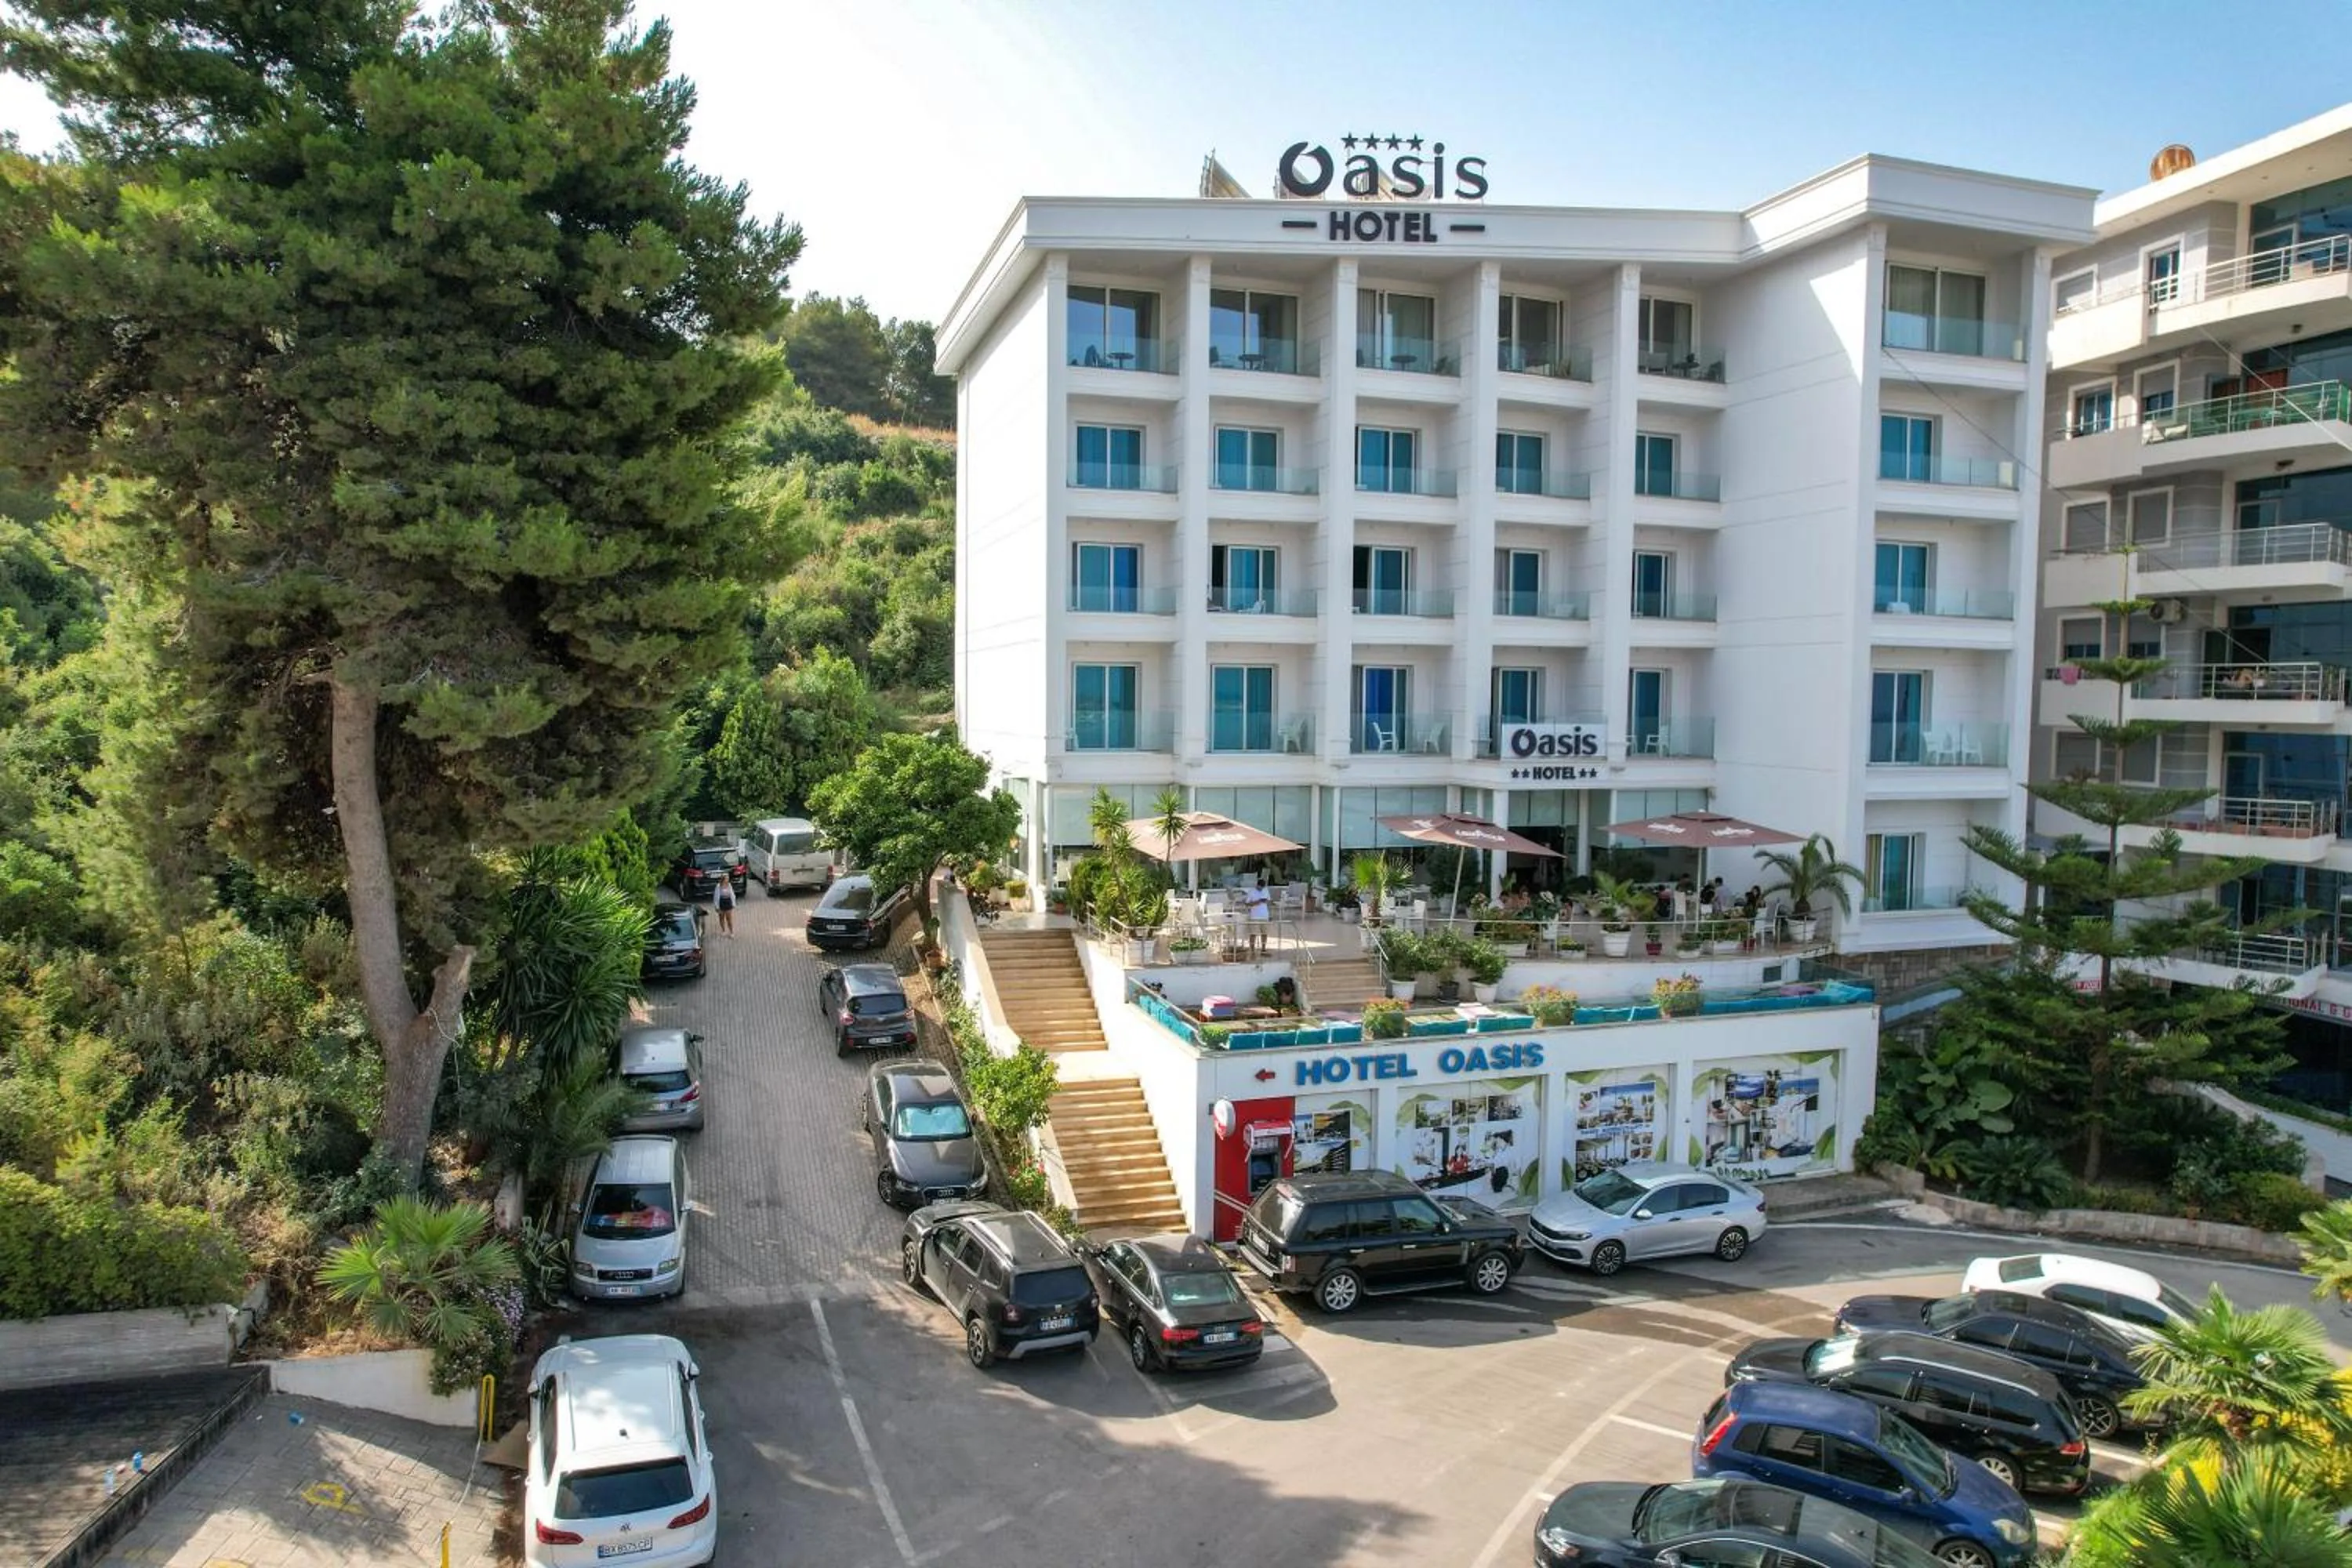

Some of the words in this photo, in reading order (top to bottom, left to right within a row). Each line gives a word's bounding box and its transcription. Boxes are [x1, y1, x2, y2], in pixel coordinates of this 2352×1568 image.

[1279, 142, 1488, 198] Oasis
[1330, 211, 1438, 242] HOTEL
[1512, 726, 1598, 757] Oasis
[1533, 767, 1576, 780] HOTEL
[1296, 1053, 1417, 1086] HOTEL
[1438, 1041, 1544, 1074] OASIS
